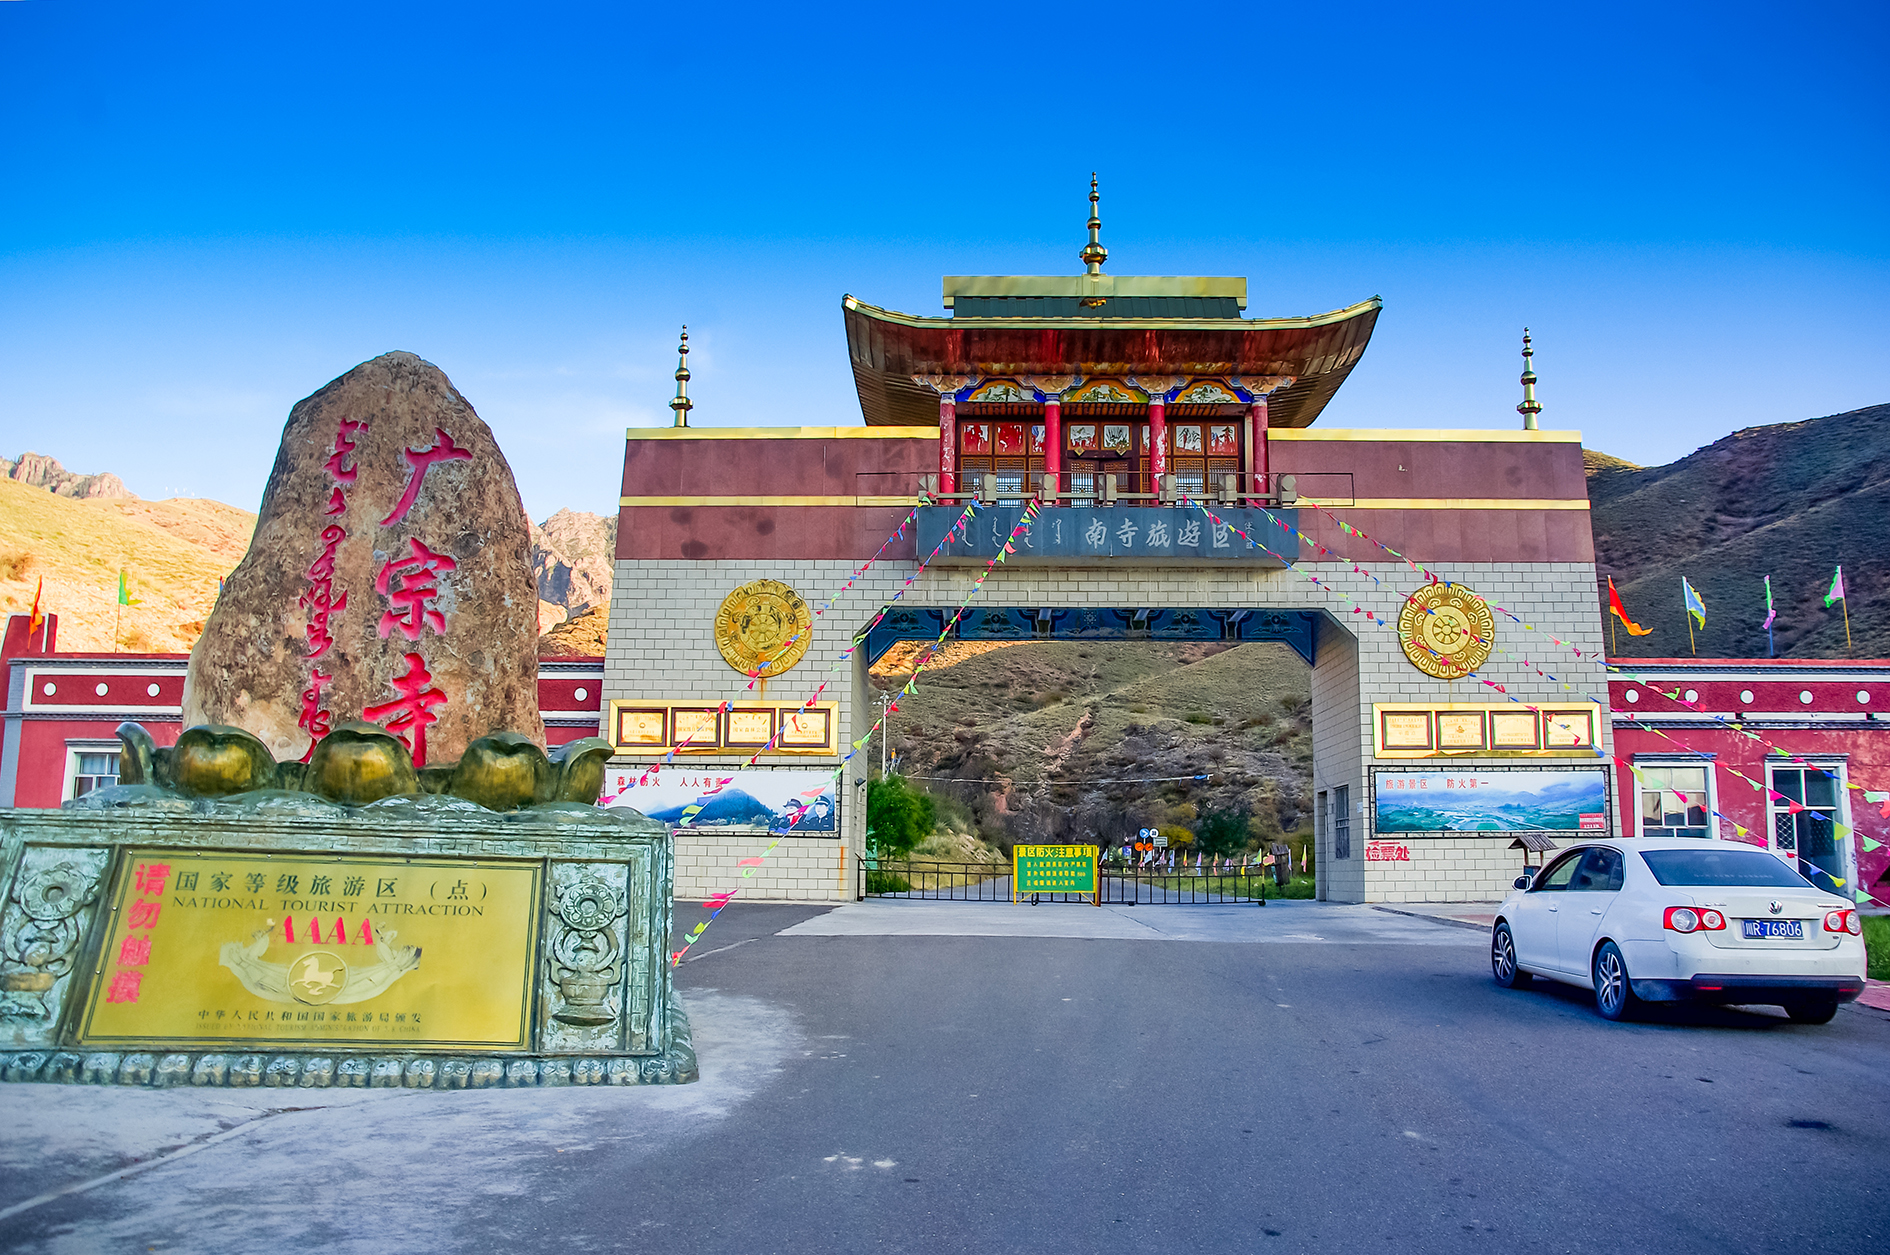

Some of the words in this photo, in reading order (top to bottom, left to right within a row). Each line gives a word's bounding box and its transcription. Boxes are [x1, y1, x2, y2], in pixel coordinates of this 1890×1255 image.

[363, 426, 473, 768] 广宗寺
[1385, 778, 1428, 790] 旅游景区
[1446, 778, 1489, 789] 防火第一
[1365, 844, 1411, 862] 检票处
[172, 896, 270, 911] NATIONAL
[280, 899, 358, 913] TOURIST
[367, 902, 484, 917] ATTRACTION
[106, 862, 172, 1004] 请勿触摸
[273, 915, 375, 946] AAAA
[198, 1009, 422, 1024] 中华人民共和国国家旅游局颁发
